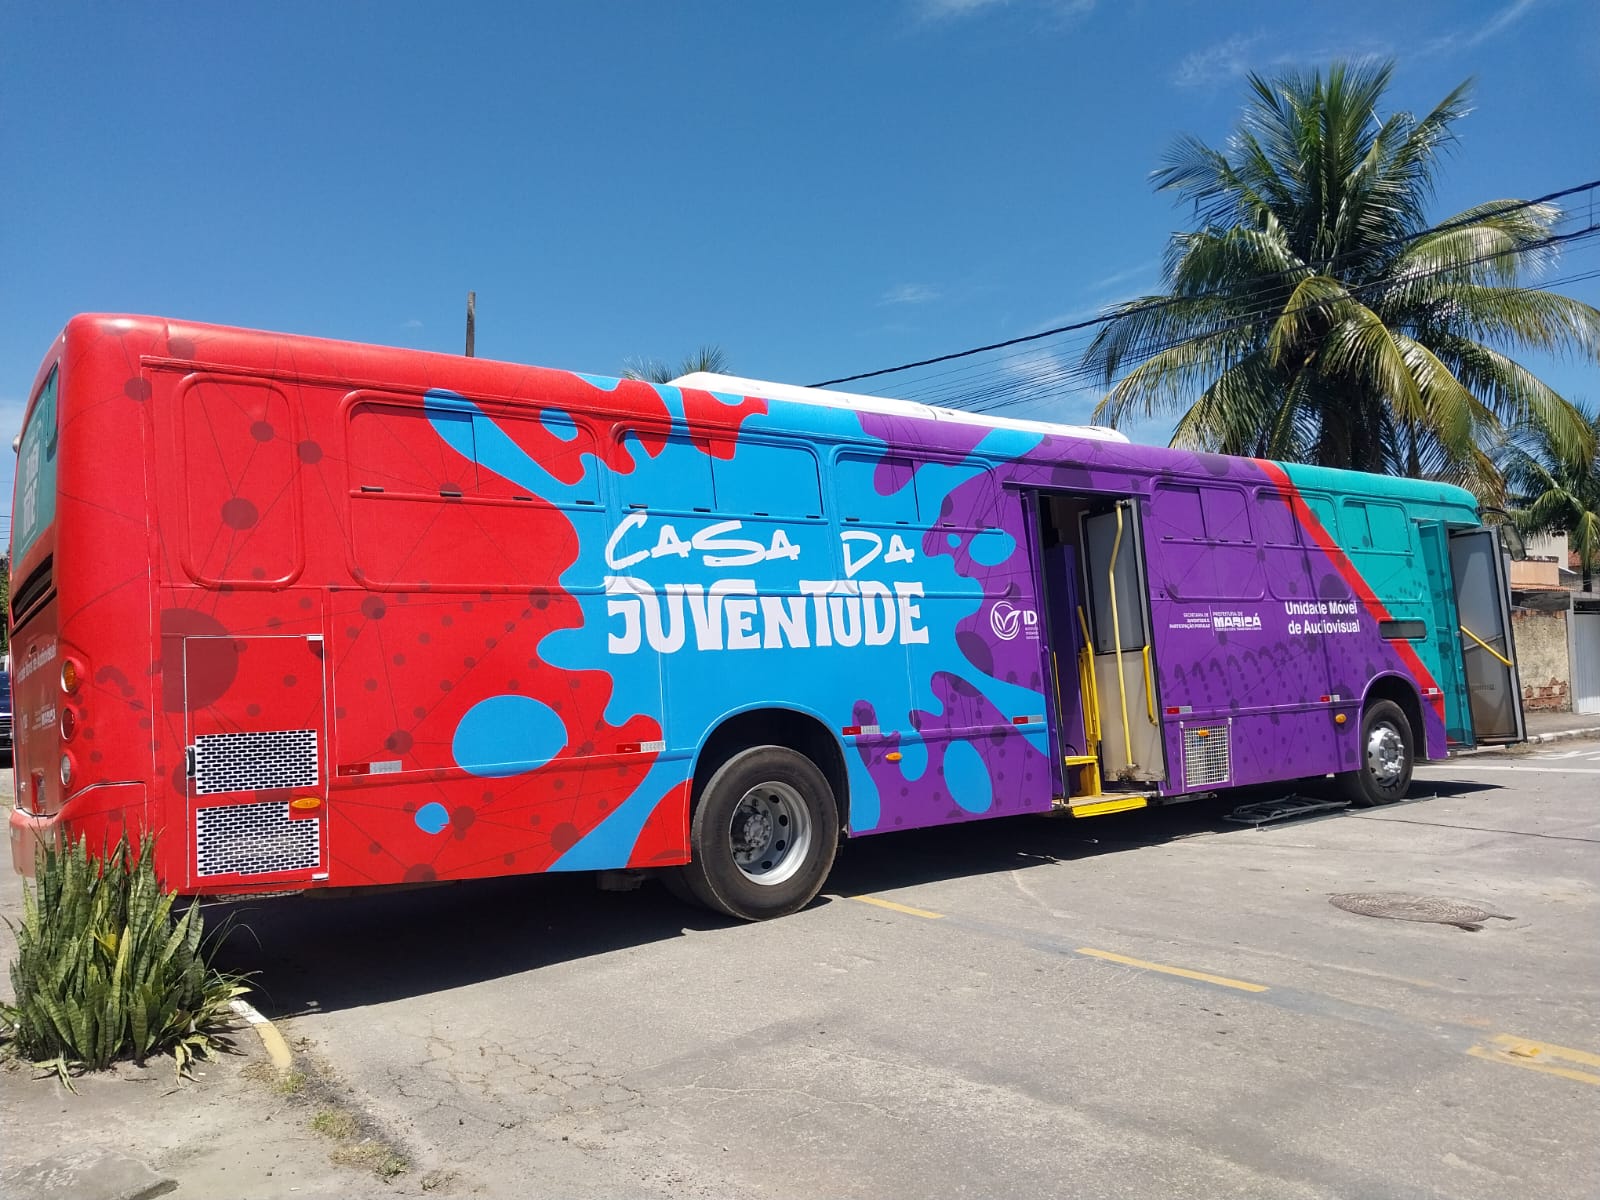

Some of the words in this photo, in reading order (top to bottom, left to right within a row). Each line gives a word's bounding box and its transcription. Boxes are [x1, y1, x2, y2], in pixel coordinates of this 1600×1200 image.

[605, 510, 801, 571] CASA
[840, 530, 915, 579] DA
[604, 576, 929, 654] JUVENTUDE
[1285, 601, 1328, 615] Unidade
[1329, 600, 1358, 614] Móvel
[1288, 620, 1301, 635] de
[1304, 619, 1361, 634] Audiovisual
